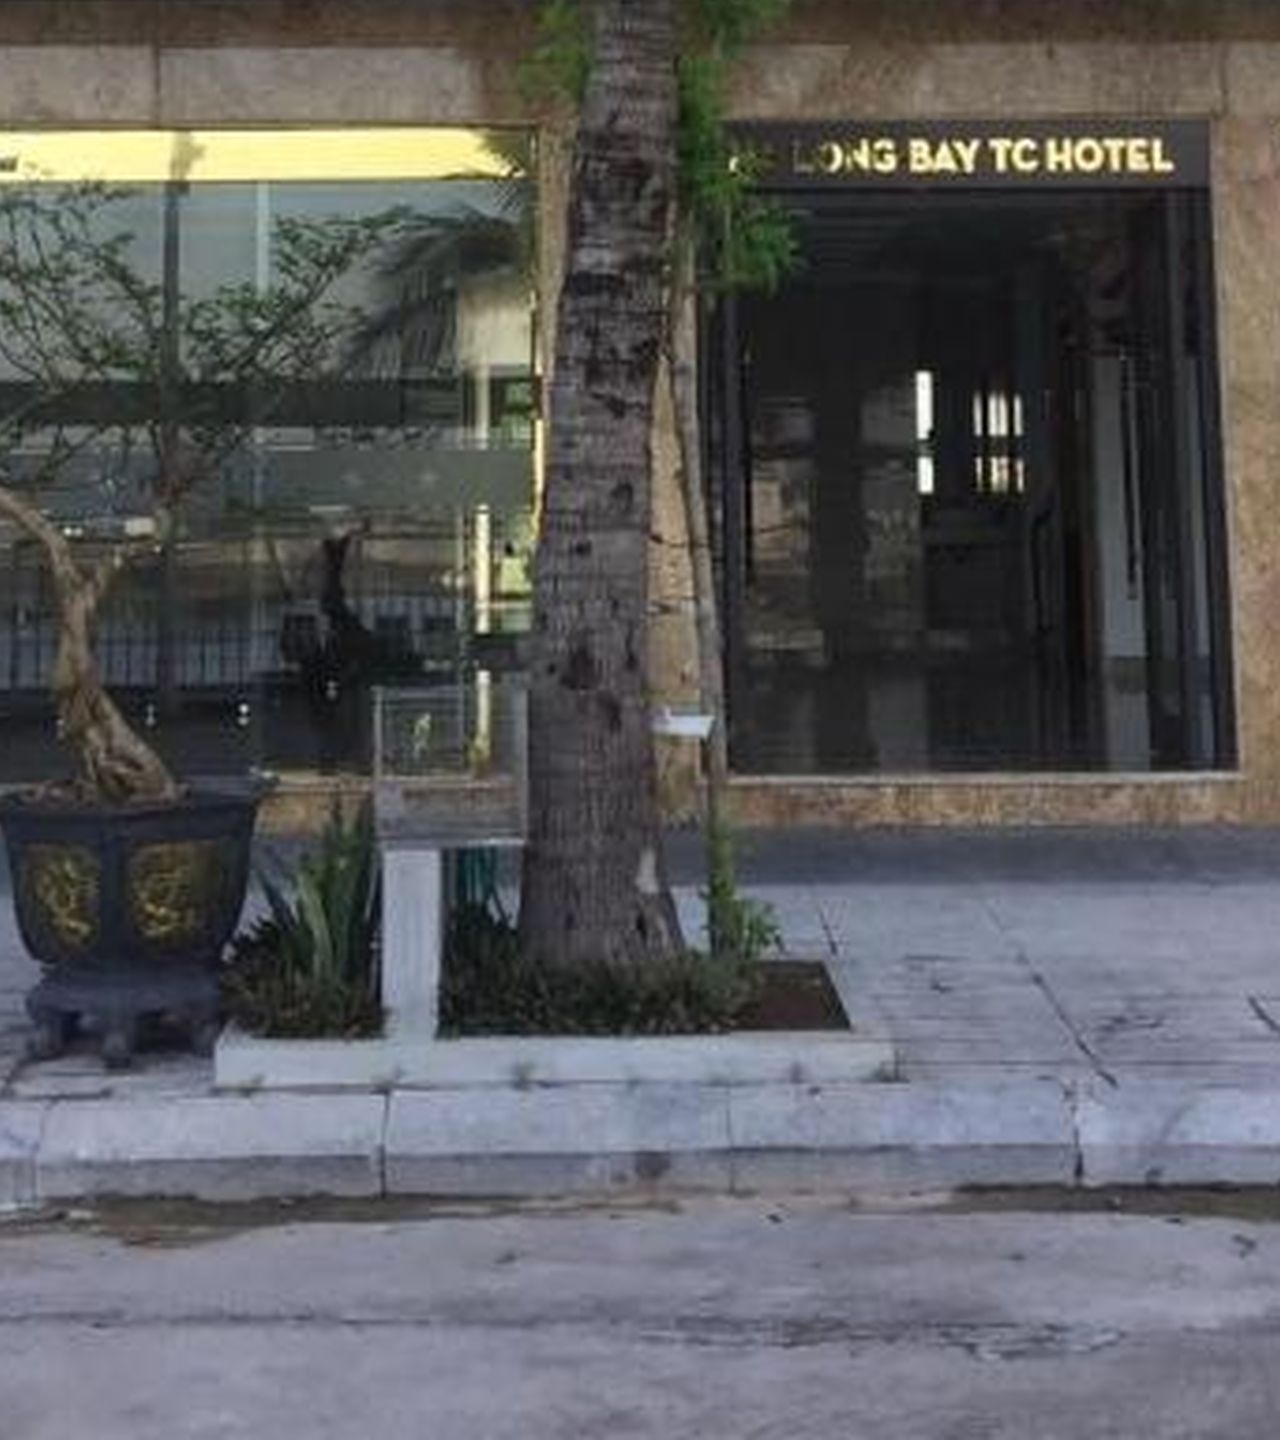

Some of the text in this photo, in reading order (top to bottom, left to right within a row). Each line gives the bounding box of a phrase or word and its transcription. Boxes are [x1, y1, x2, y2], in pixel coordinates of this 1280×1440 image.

[909, 138, 980, 174] BAY
[988, 138, 1040, 173] TC
[1046, 138, 1175, 173] HOTEL
